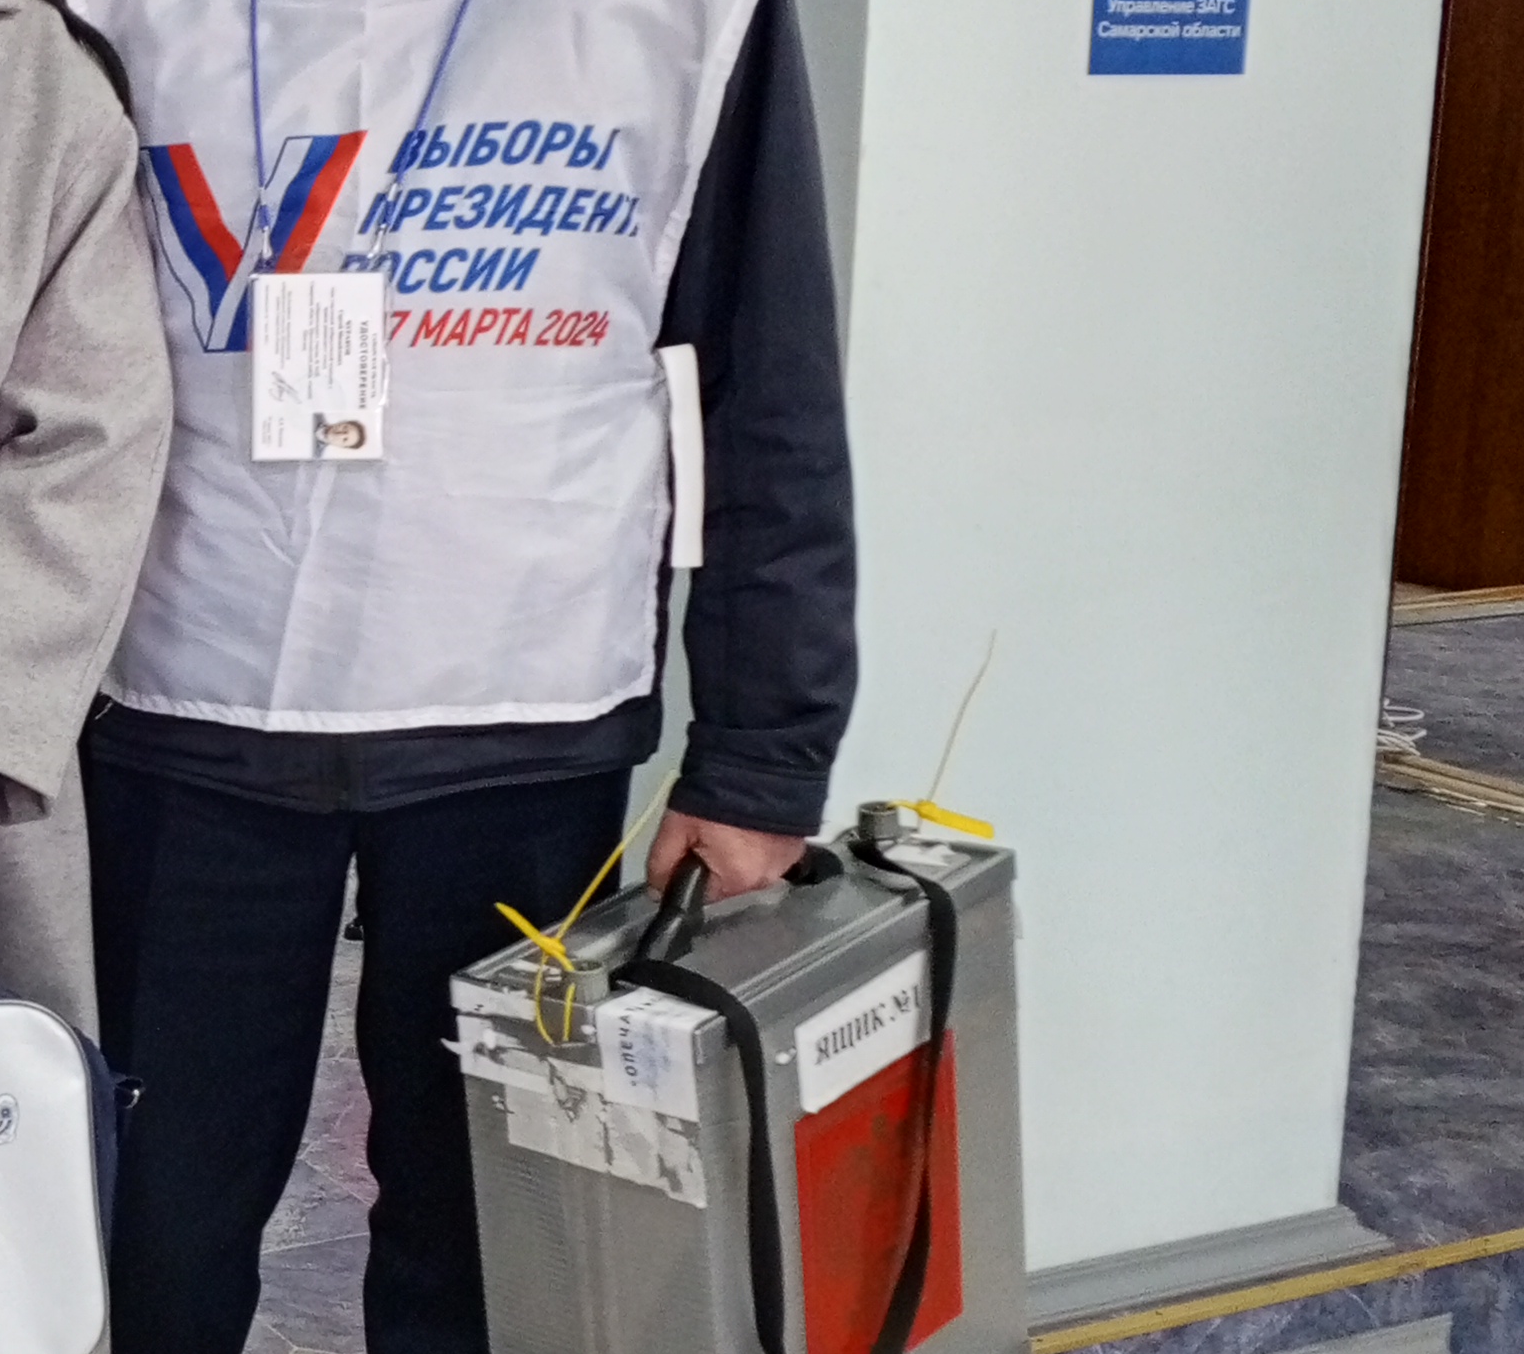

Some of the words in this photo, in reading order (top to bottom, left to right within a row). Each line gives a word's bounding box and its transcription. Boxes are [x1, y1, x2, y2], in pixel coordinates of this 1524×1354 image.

[1097, 21, 1180, 41] Самарской
[1181, 22, 1242, 39] области
[386, 120, 620, 173] ВЫБОРЫ
[409, 307, 533, 347] МАРТА
[534, 308, 610, 347] 2024
[358, 320, 369, 410] УДОСТОВЕРЕНИЕ
[815, 1002, 886, 1065] ЯЩИК
